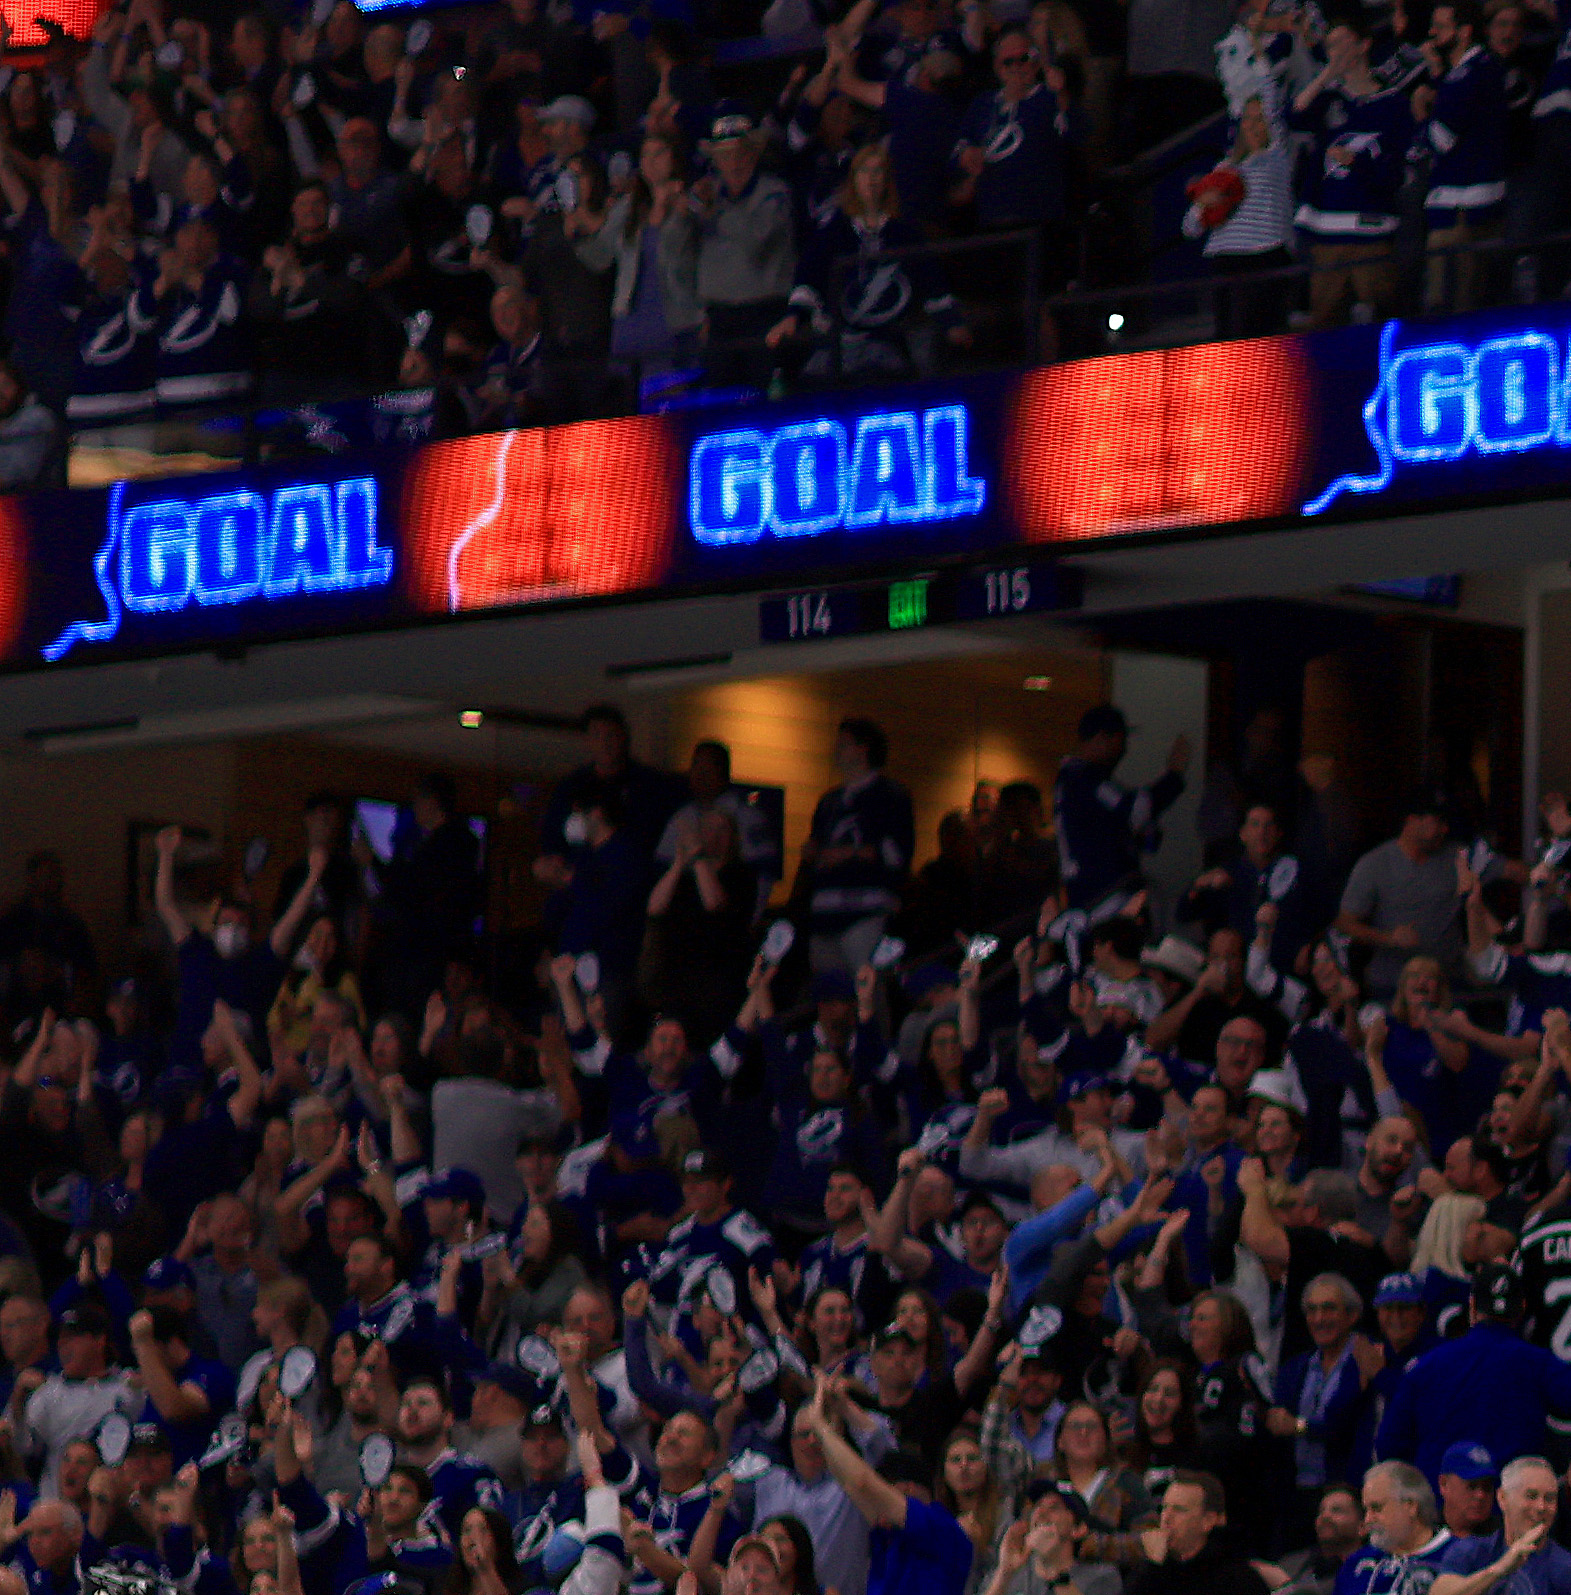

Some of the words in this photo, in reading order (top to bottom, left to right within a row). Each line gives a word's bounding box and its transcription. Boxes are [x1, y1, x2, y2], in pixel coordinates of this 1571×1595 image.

[690, 405, 986, 545] GOAL
[119, 478, 393, 611] GOAL
[788, 595, 831, 638] 114
[985, 569, 1031, 614] 115
